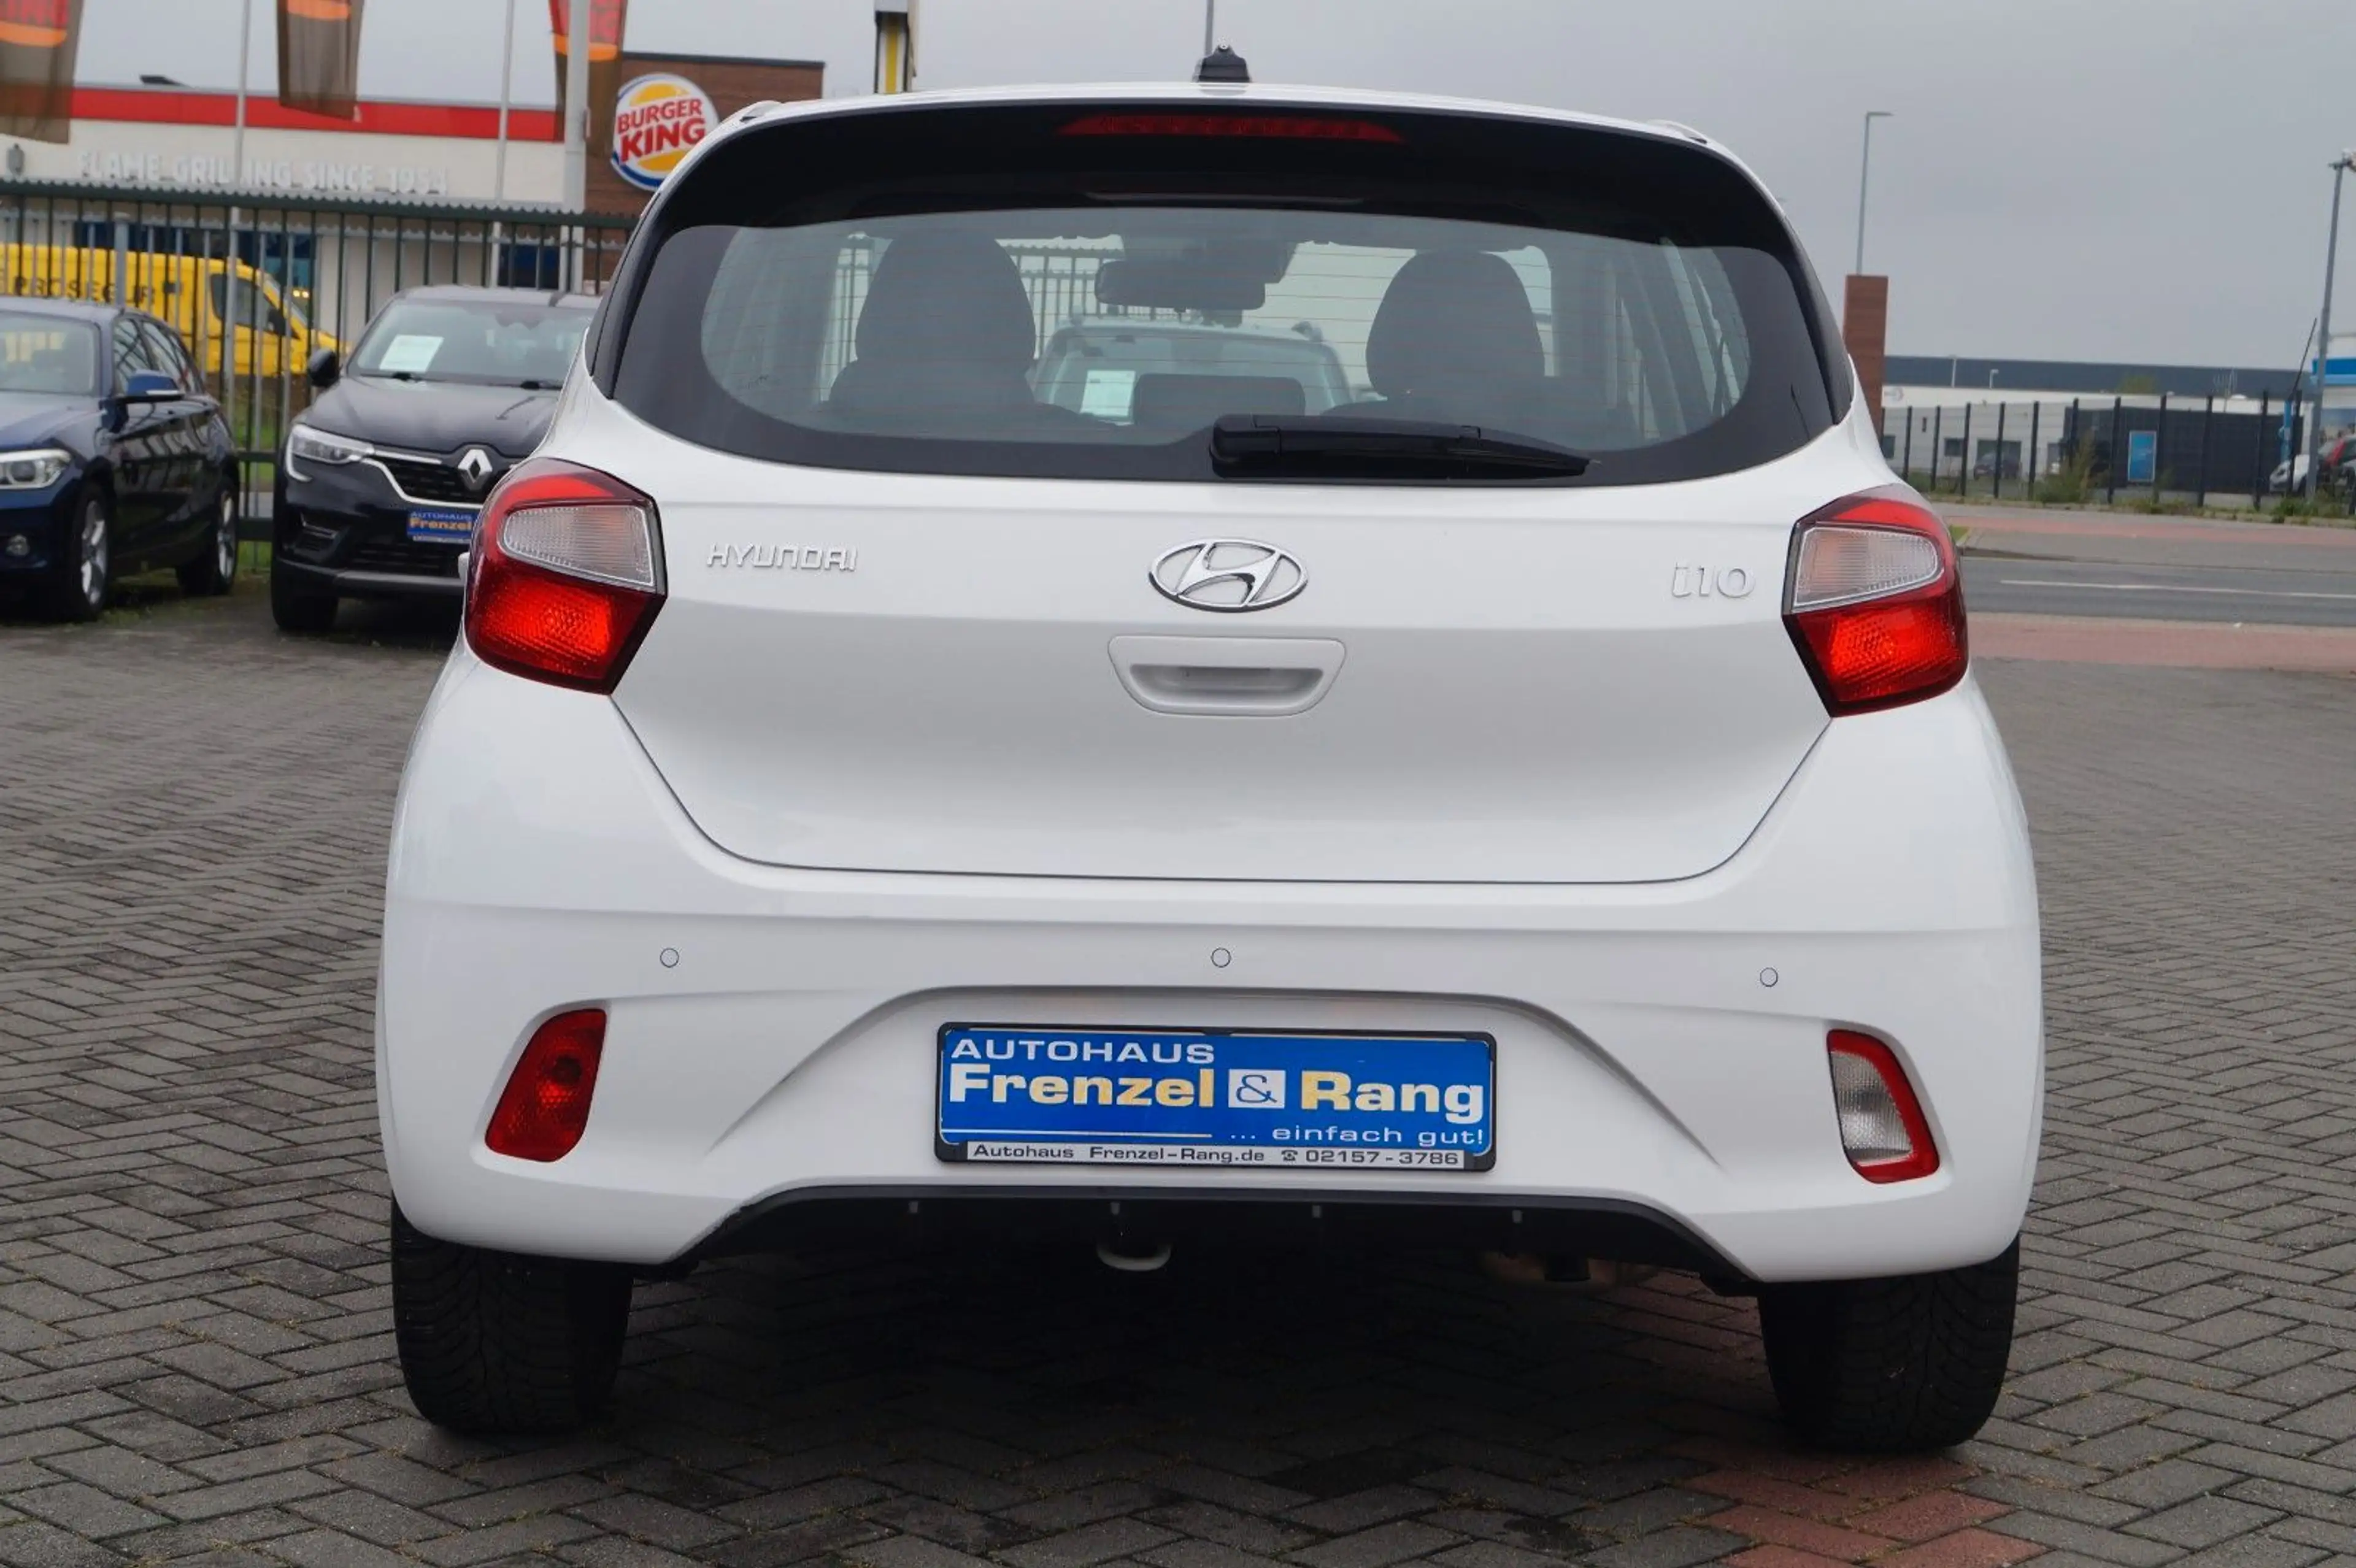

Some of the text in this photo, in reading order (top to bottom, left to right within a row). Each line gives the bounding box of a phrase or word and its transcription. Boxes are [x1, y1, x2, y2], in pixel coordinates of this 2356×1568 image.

[617, 99, 702, 134] BURGER
[620, 118, 706, 163] KING
[78, 152, 448, 196] FLAME GRILING SINCE 1954
[409, 517, 472, 531] Frenzel
[707, 542, 857, 571] HYUNDAI
[951, 1039, 1215, 1064] AUTOHAUS
[949, 1063, 1484, 1124] Frenzel & Rang
[1272, 1126, 1403, 1143] einfach
[1418, 1129, 1484, 1147] gut!
[973, 1144, 1074, 1158] Autohaus
[1089, 1146, 1265, 1164] Frenzel-Rang.de
